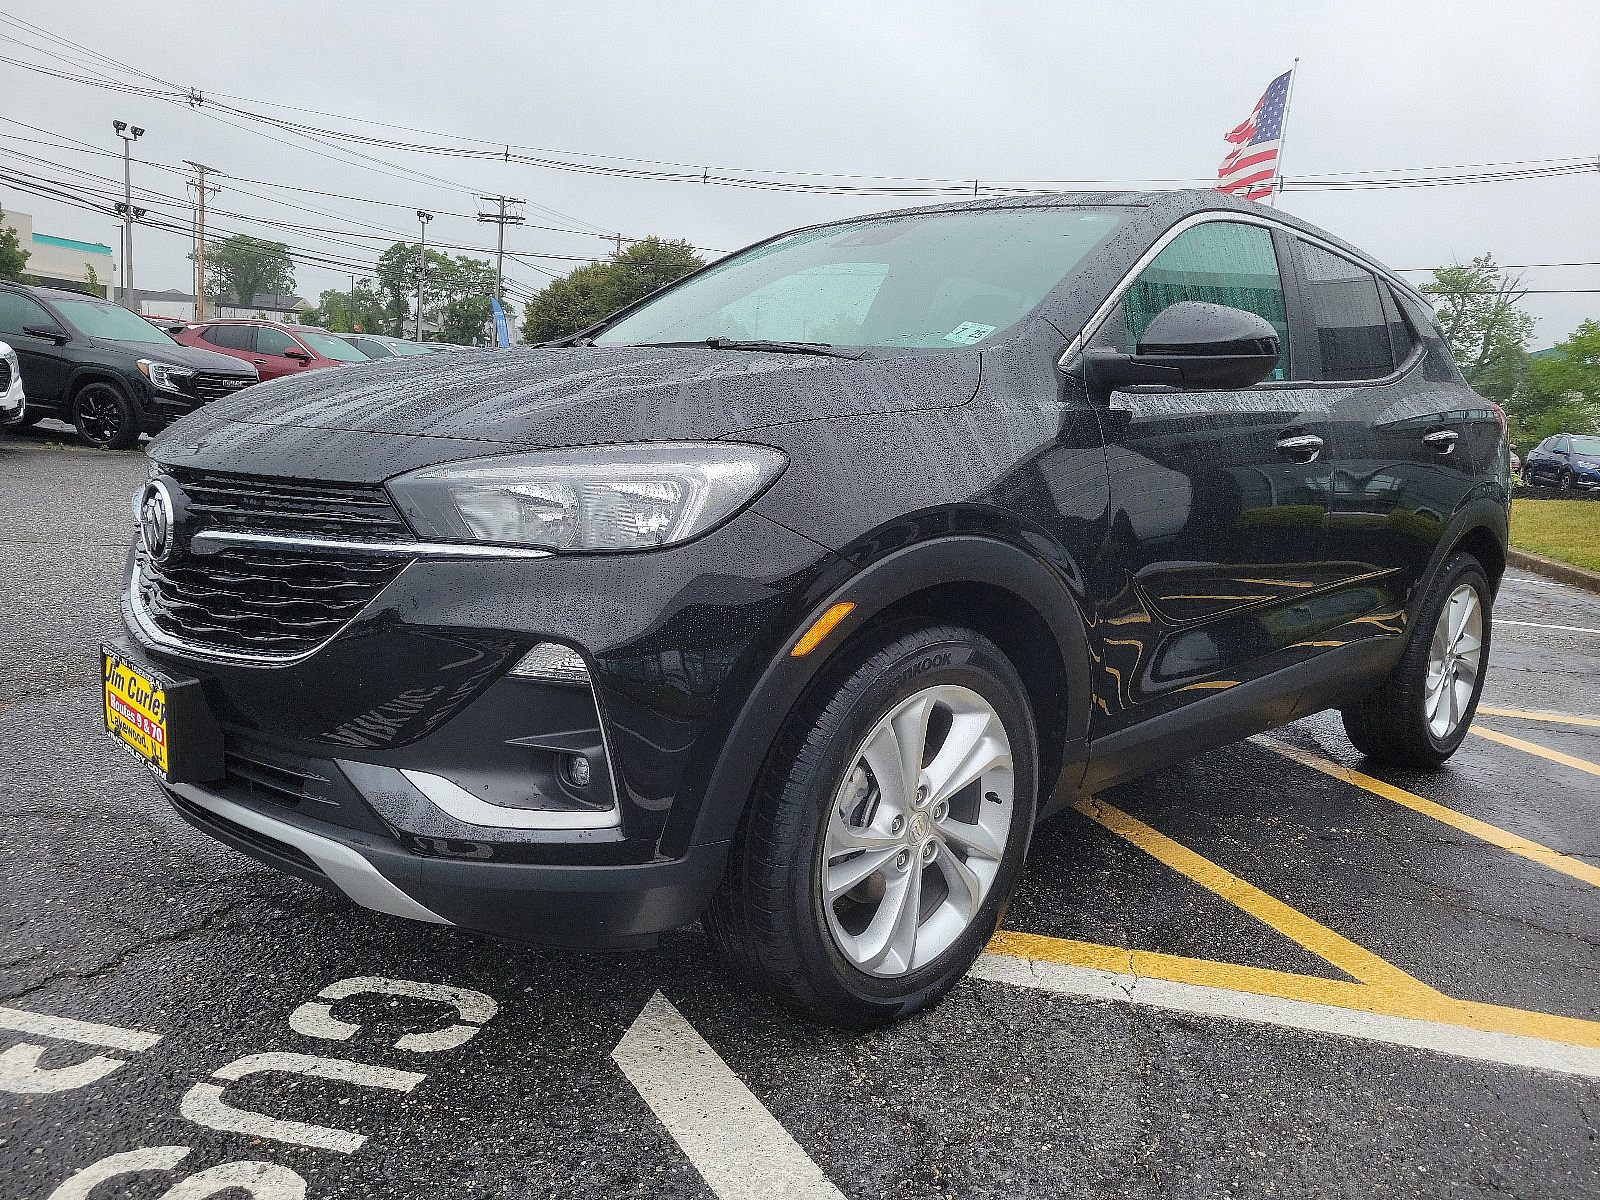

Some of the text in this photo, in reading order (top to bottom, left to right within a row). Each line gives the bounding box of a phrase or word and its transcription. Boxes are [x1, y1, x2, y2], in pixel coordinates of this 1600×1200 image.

[105, 661, 166, 725] Jim Curley
[110, 692, 163, 743] Routes 9 & 70
[150, 739, 166, 764] NJ.
